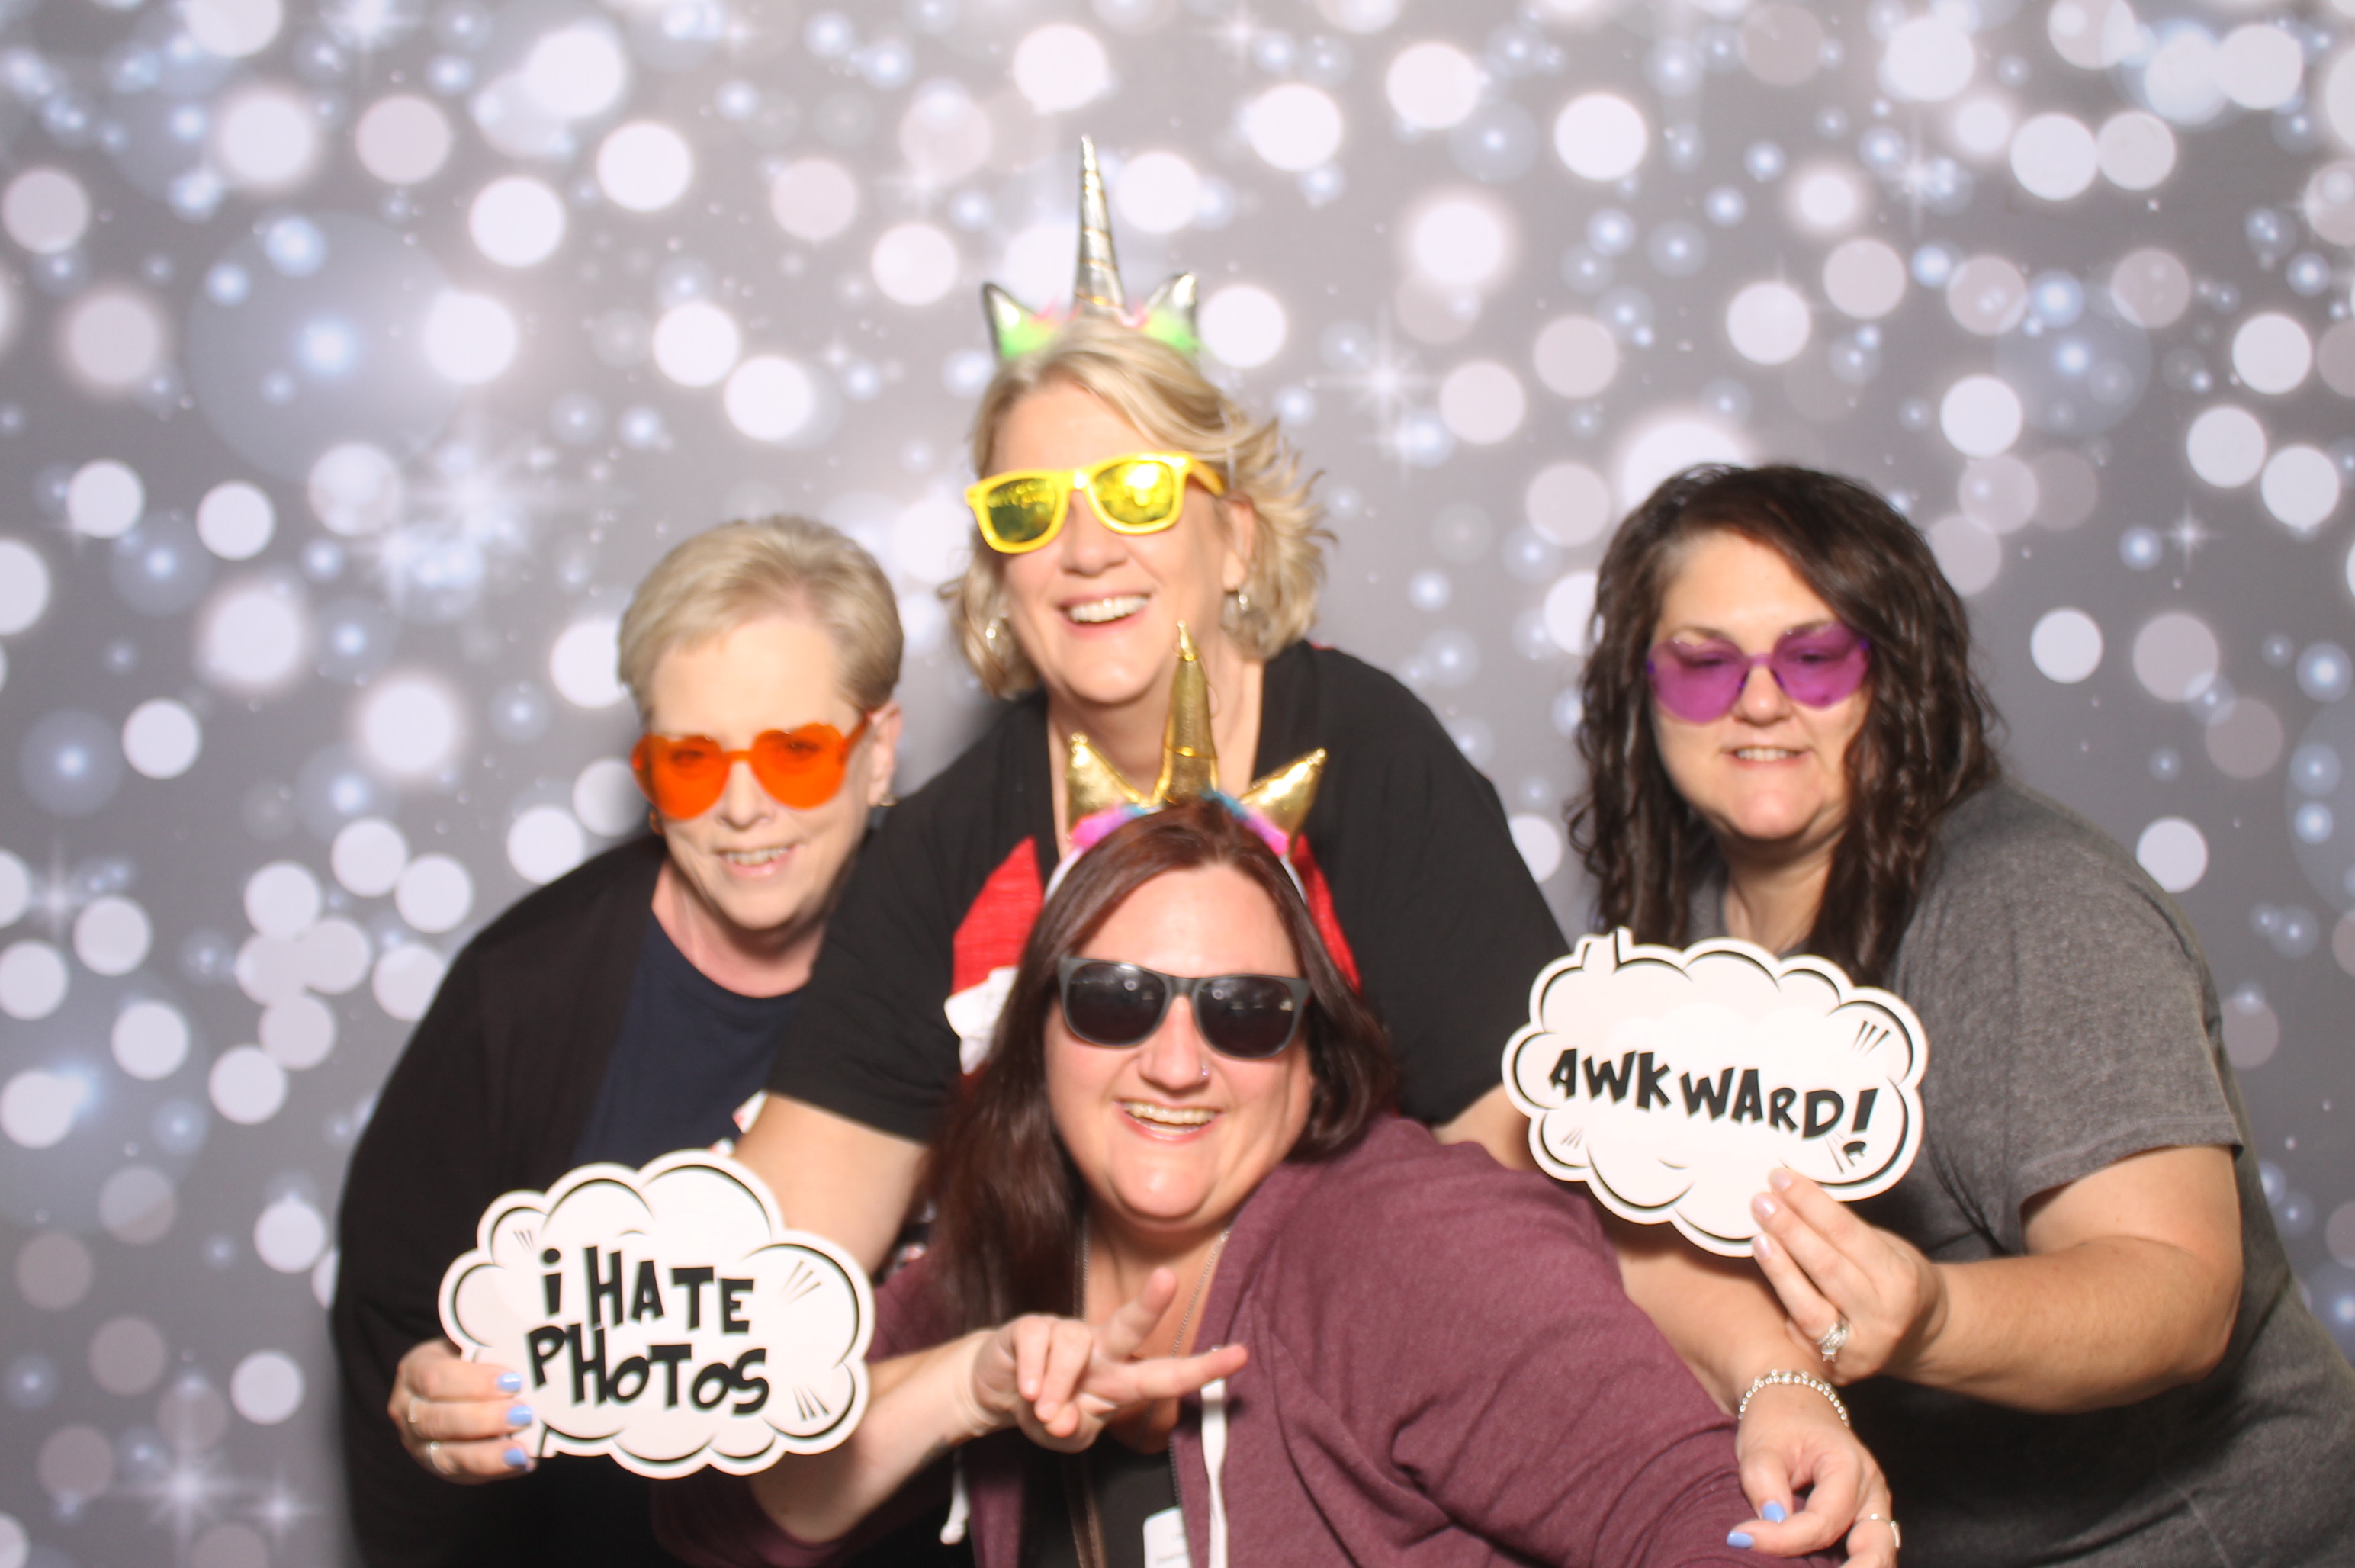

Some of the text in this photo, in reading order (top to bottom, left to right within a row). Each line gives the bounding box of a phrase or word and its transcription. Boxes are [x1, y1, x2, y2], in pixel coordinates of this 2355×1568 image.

[1549, 1047, 1879, 1157] AWKWARD!
[583, 1245, 755, 1335] HATE
[526, 1321, 770, 1415] PHOTOS
